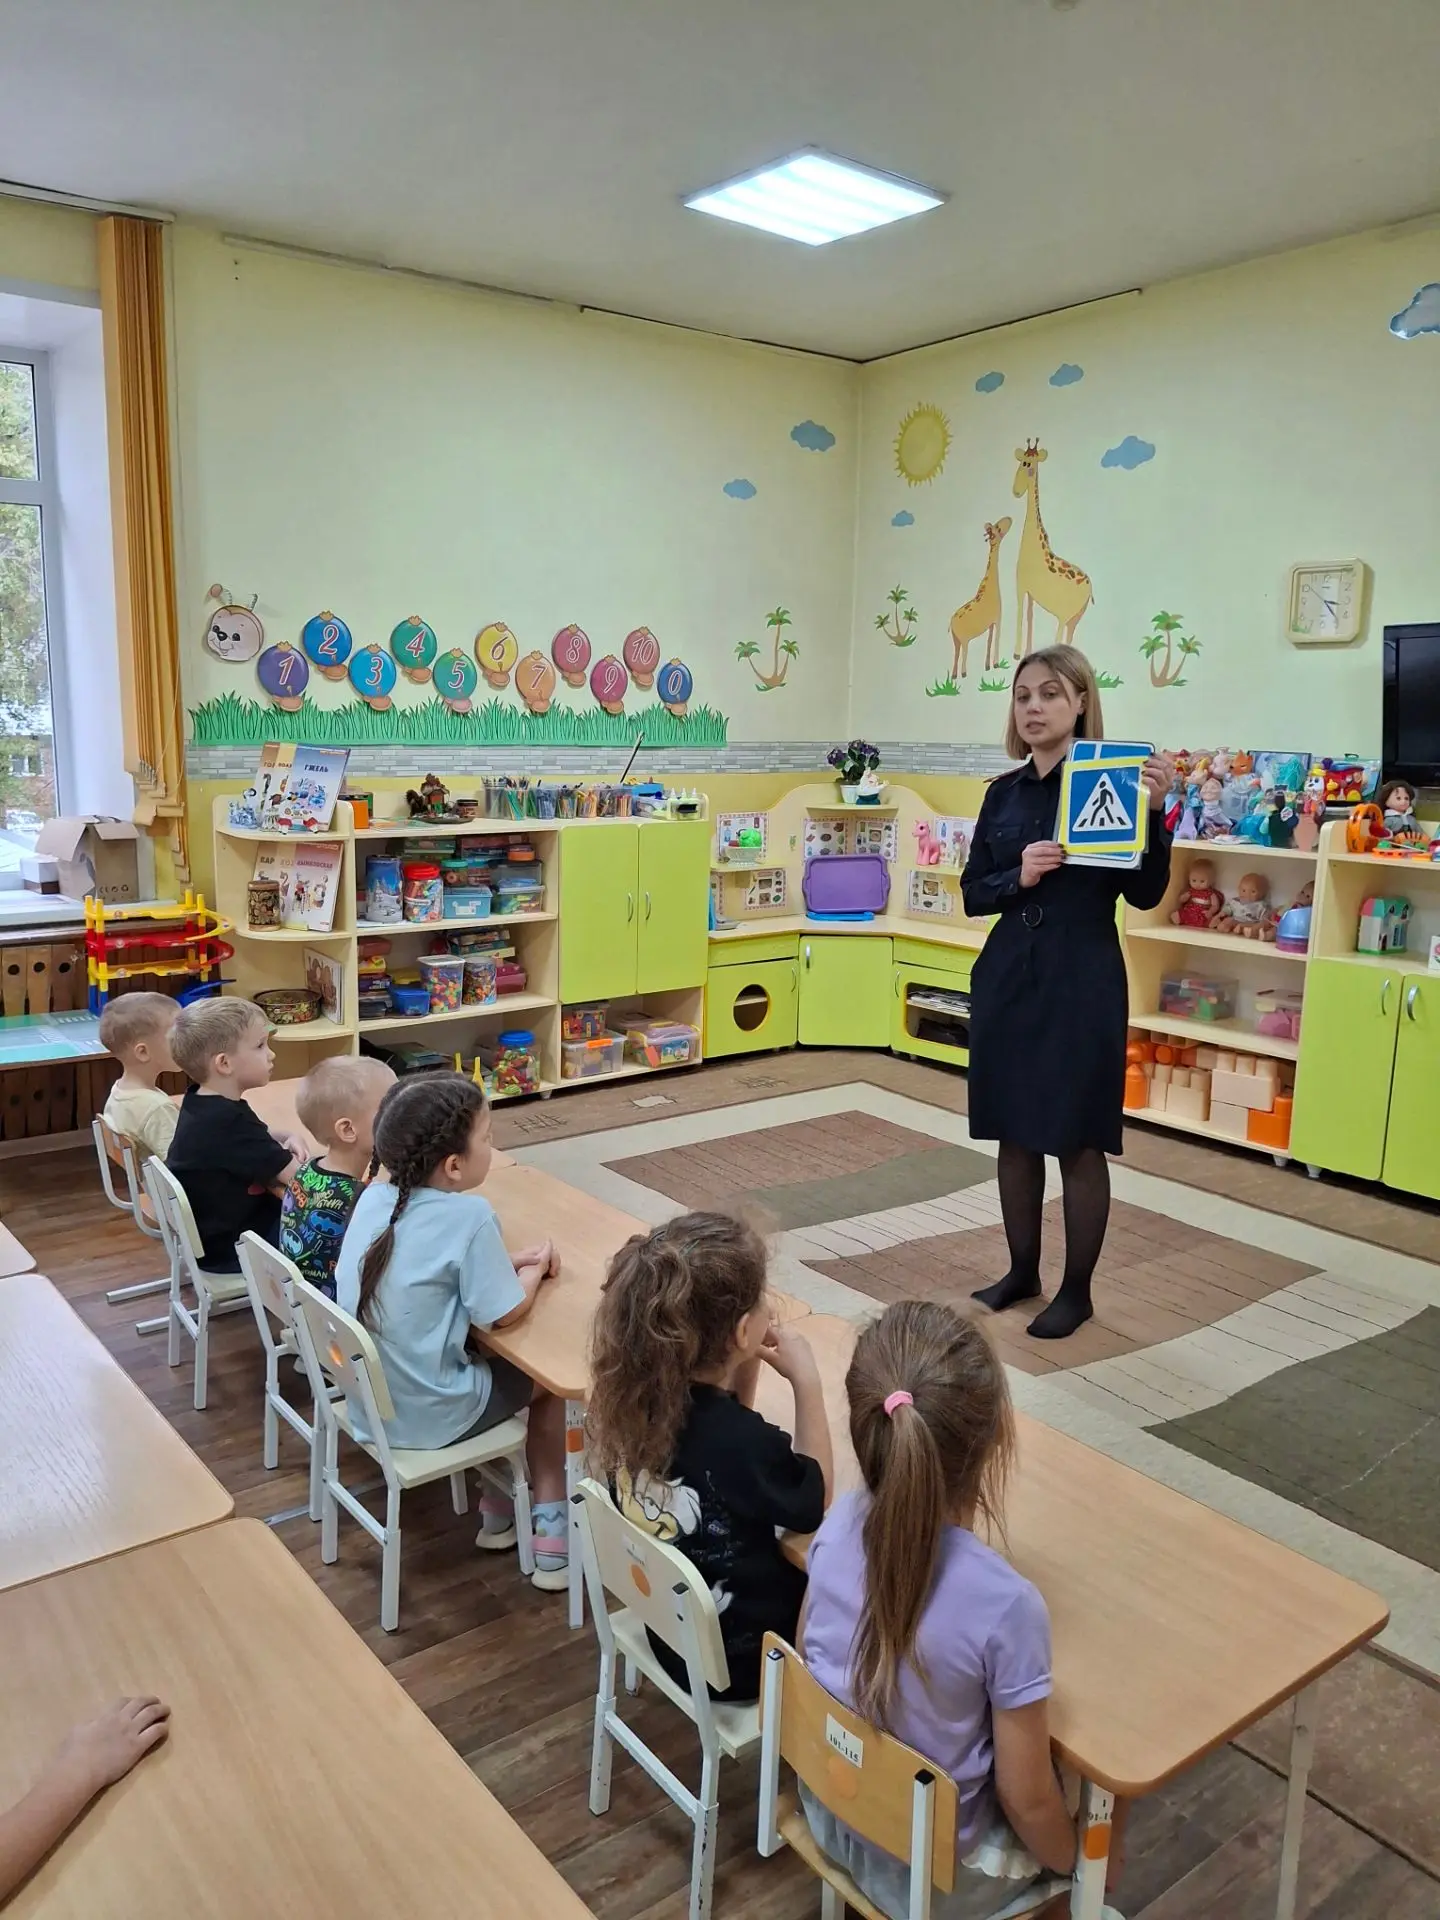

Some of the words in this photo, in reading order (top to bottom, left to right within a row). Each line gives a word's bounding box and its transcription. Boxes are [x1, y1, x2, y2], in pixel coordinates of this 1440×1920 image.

[318, 624, 339, 655] 2
[405, 629, 427, 658] 4
[491, 636, 509, 661] 6
[566, 635, 582, 664] 8
[631, 637, 654, 665] 10
[278, 654, 295, 686] 1
[365, 656, 384, 687] 3
[448, 660, 467, 689] 5
[530, 664, 548, 690] 7
[604, 665, 620, 694] 9
[668, 669, 682, 696] 0
[304, 764, 329, 773] ГЖЕЛЬ
